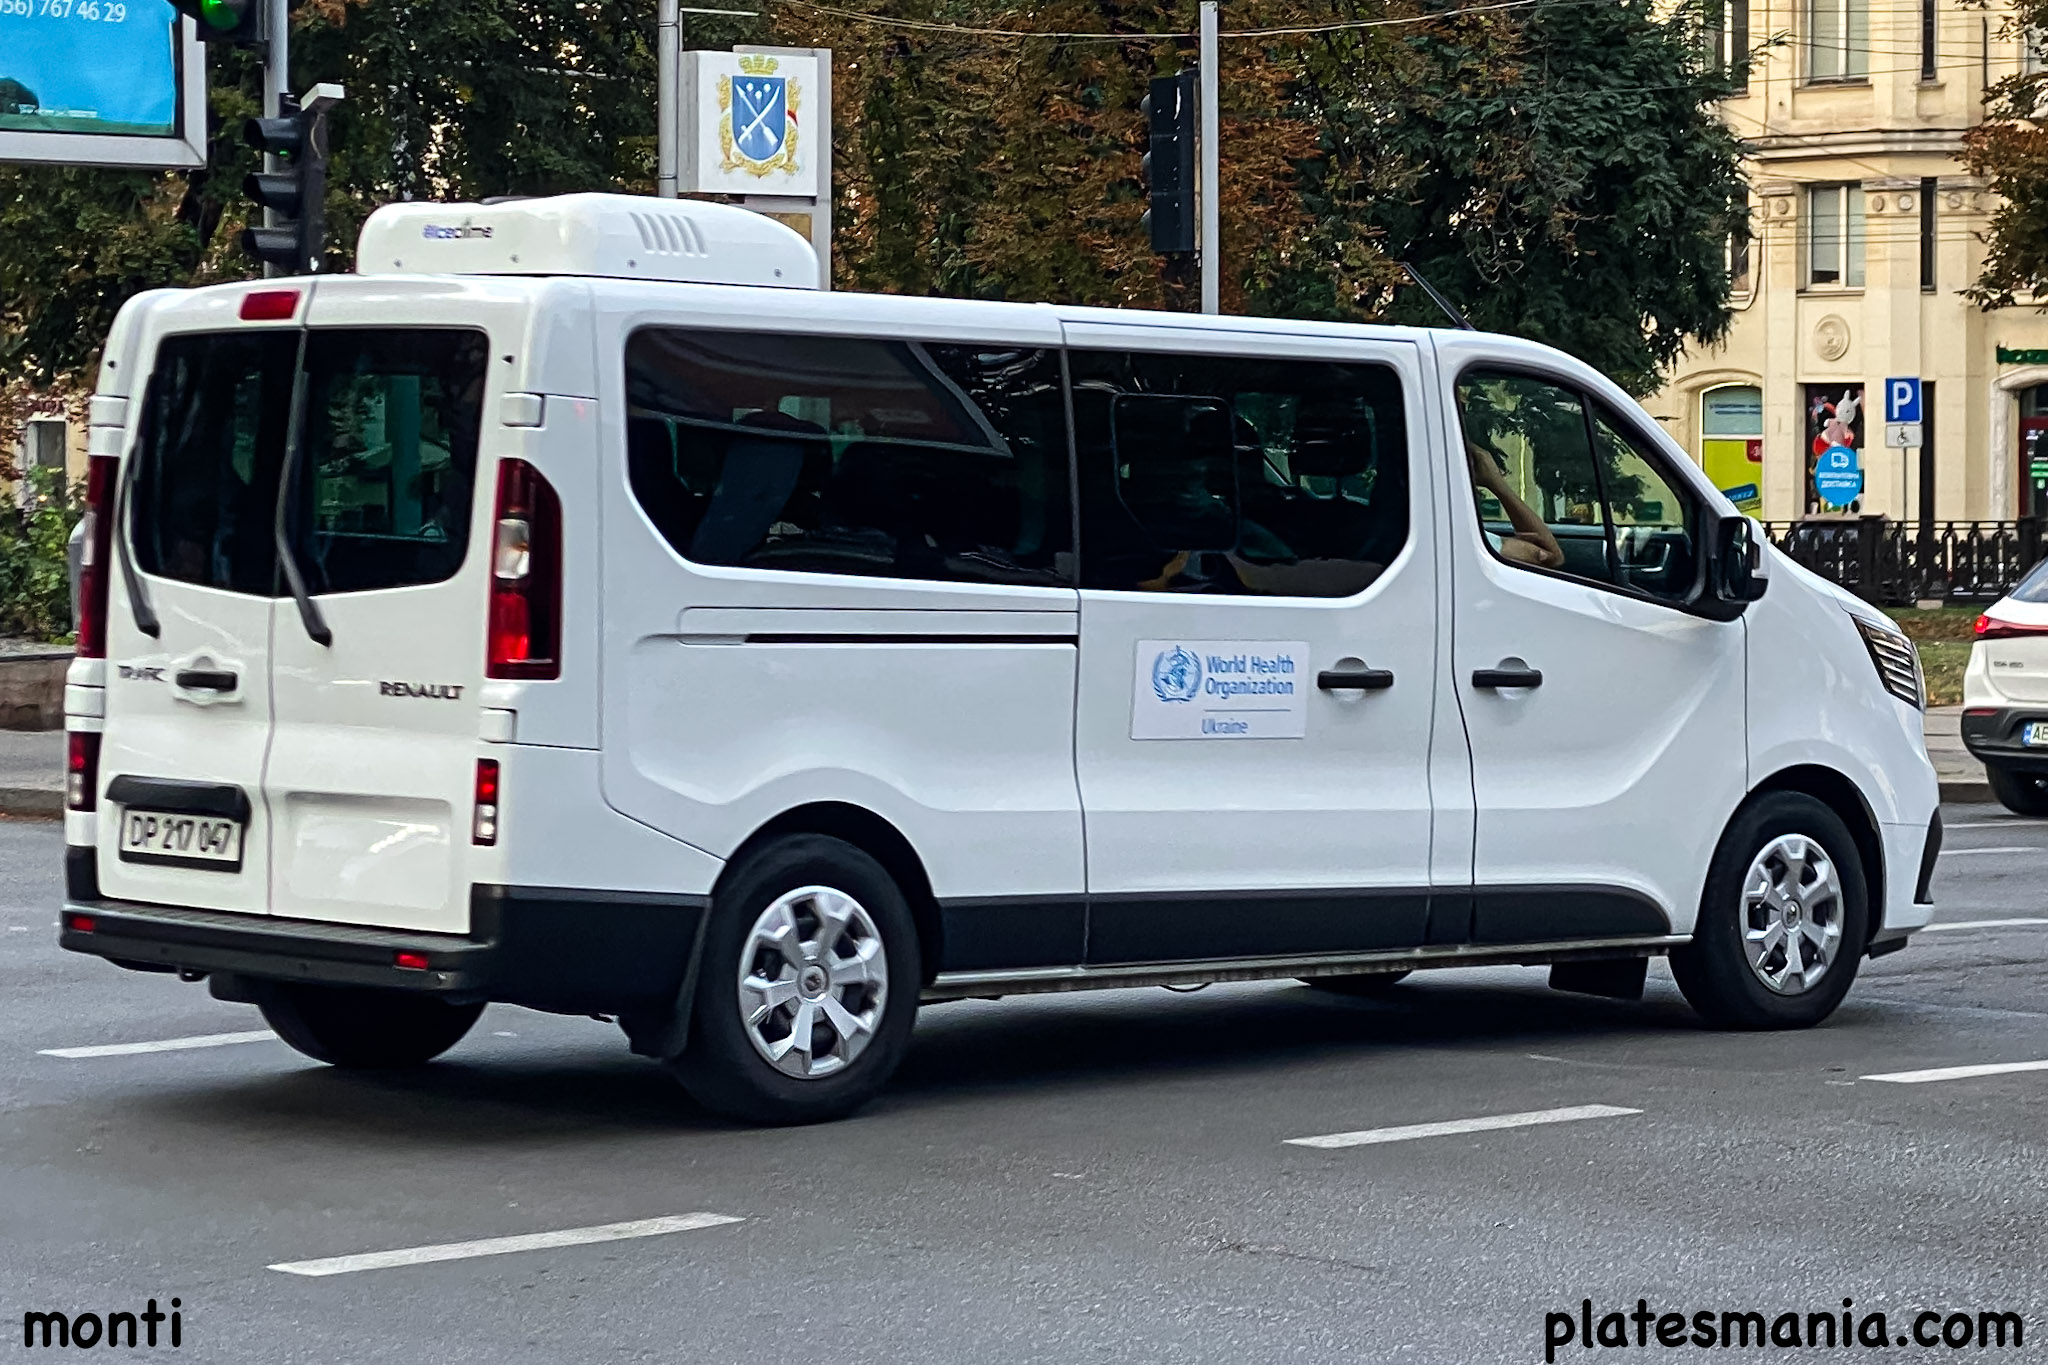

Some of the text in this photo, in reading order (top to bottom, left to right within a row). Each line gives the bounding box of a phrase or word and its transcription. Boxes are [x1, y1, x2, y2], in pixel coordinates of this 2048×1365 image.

[0, 0, 126, 22] 56) 767 46 29
[1892, 381, 1913, 420] P
[1206, 654, 1294, 675] World Health
[379, 681, 464, 699] RENAULT
[1205, 677, 1294, 699] Organization
[1201, 717, 1248, 734] Ukraine
[130, 815, 232, 854] DP 217 047
